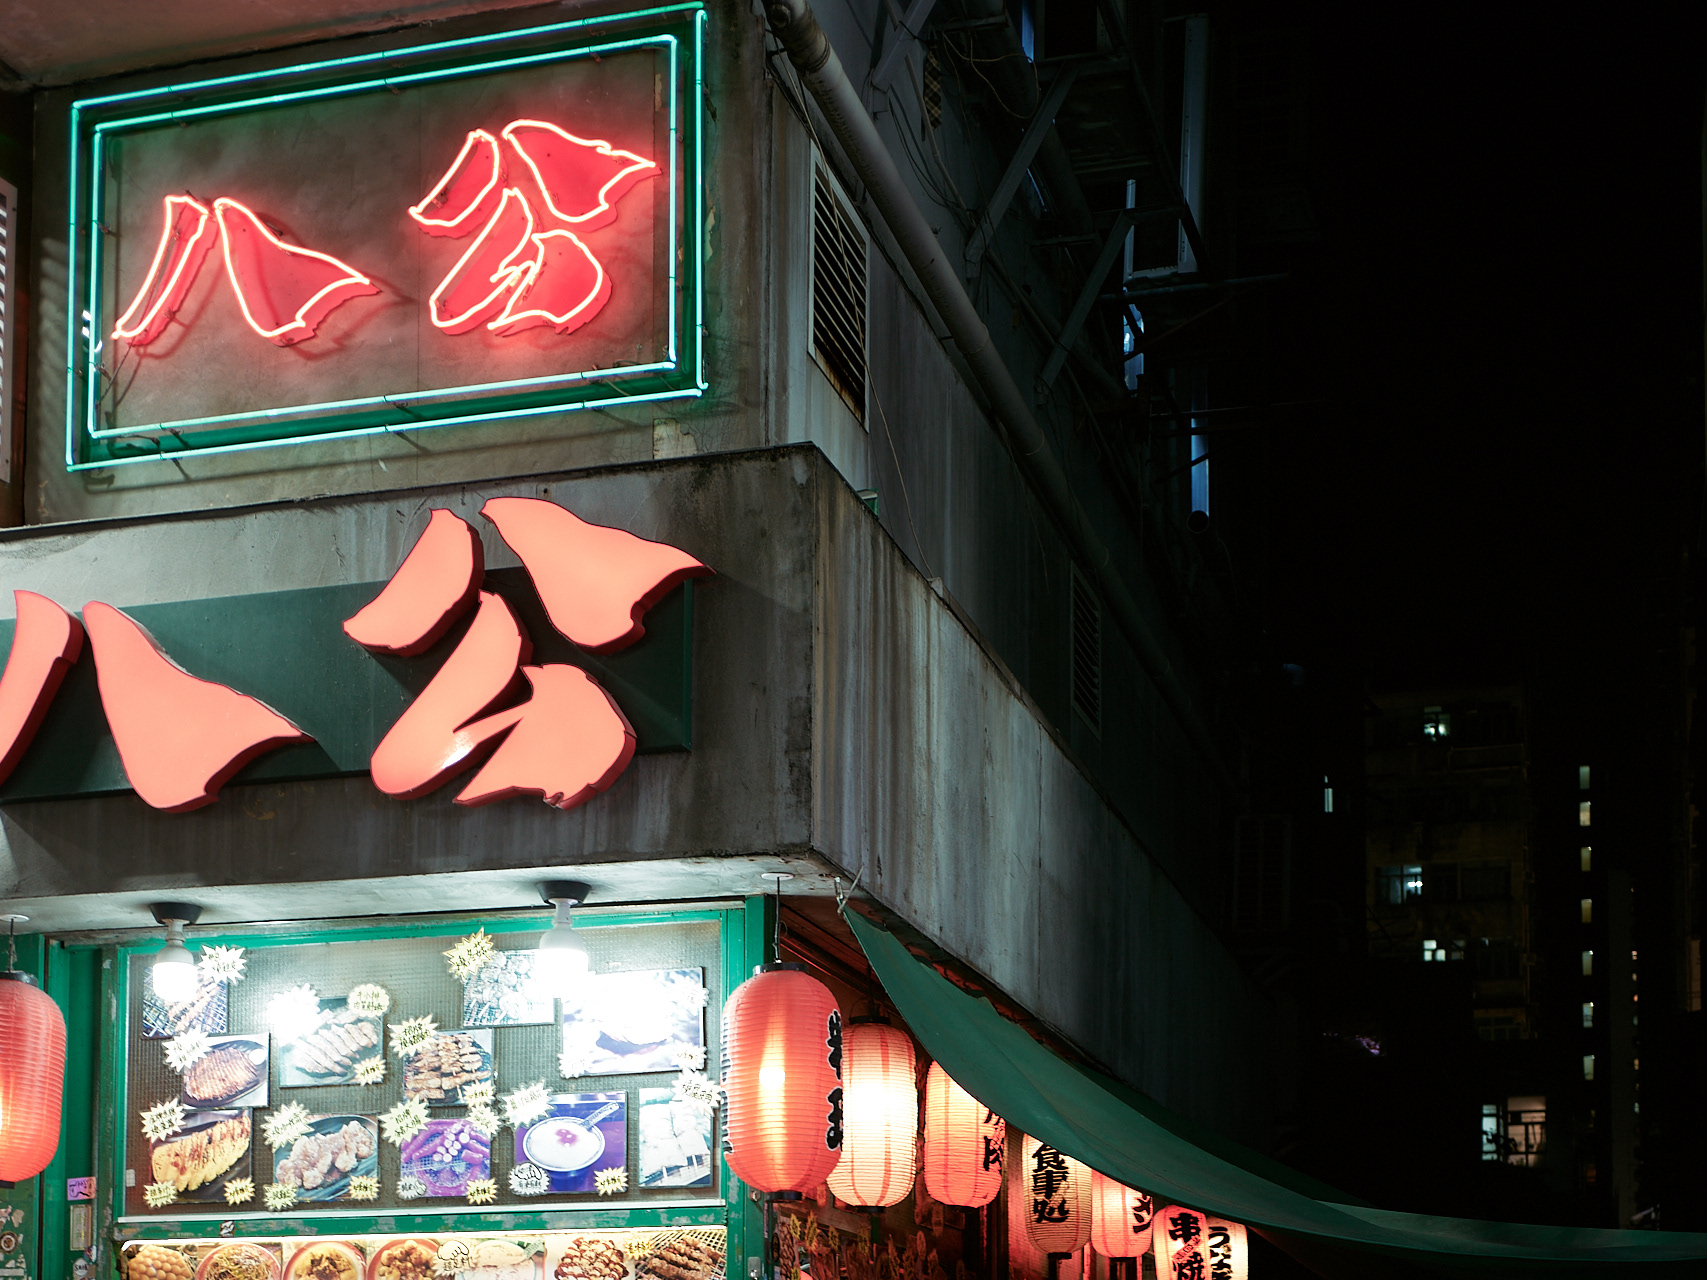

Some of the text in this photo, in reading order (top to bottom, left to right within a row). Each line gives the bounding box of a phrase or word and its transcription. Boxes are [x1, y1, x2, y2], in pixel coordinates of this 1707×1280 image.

[110, 118, 663, 346] 八公
[0, 497, 705, 812] 八公
[1132, 1192, 1152, 1234] メン
